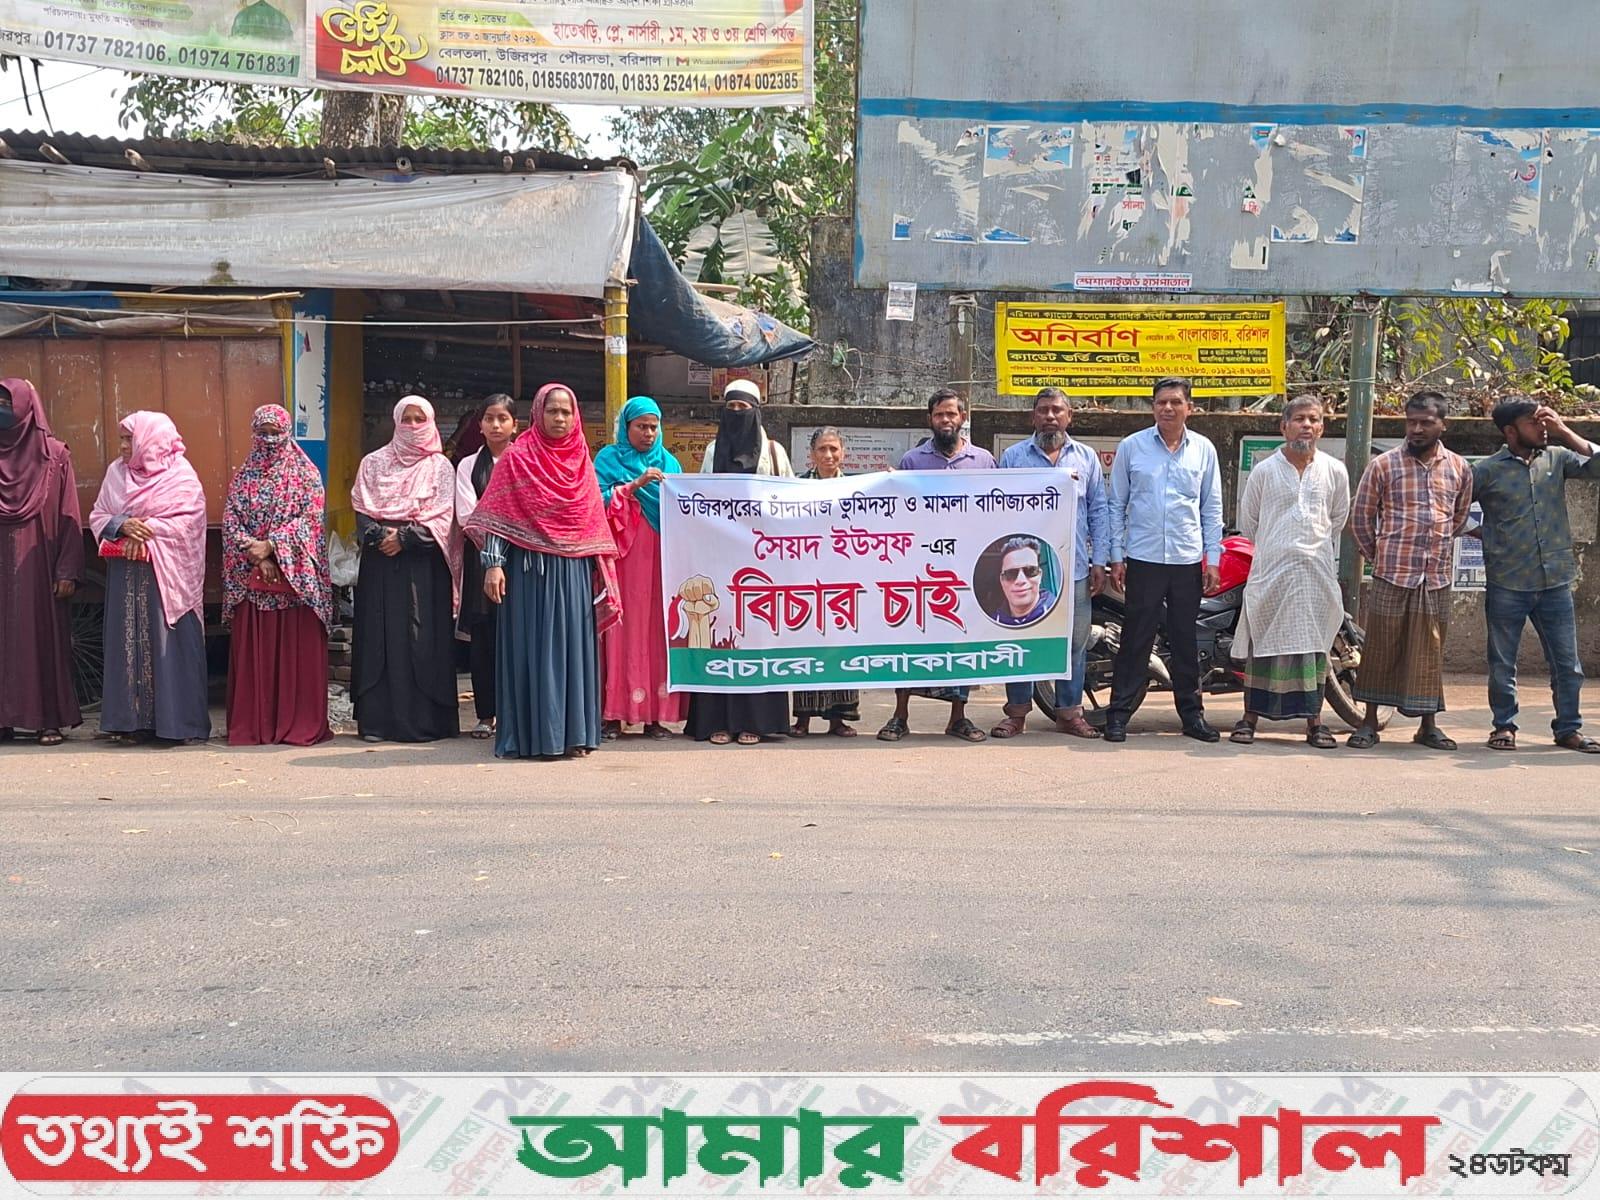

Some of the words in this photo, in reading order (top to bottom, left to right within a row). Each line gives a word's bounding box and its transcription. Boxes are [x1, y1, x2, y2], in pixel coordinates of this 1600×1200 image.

[711, 27, 720, 41] ও
[44, 31, 98, 54] 01737
[103, 38, 172, 64] 782106,
[178, 47, 230, 69] 01974
[236, 53, 296, 74] 761831
[496, 47, 548, 65] উজিরপুর
[559, 50, 613, 67] পৌরসভা,
[619, 52, 663, 67] বরিশাল
[436, 66, 475, 85] 01737
[478, 68, 530, 91] 782106,
[622, 74, 660, 92] 01833
[714, 74, 750, 91] 01874
[754, 72, 799, 90] 002385
[1010, 323, 1141, 348] অনির্বাণ
[1177, 326, 1232, 344] বাংলাবাজার,
[1236, 323, 1270, 343] বরিশাল
[1009, 351, 1057, 362] ক্যাডেট
[1062, 351, 1090, 362] ভর্তি
[677, 493, 763, 521] উজিরপুরের
[768, 488, 832, 519] চাঁদাবাজ
[904, 498, 917, 514] ও
[923, 493, 969, 514] মামলা
[974, 489, 1062, 514] বাণিজ্যকারী
[752, 528, 823, 562] সৈয়দ
[831, 526, 916, 564] ইউসুফ
[726, 566, 867, 637] বিচার
[875, 563, 973, 634] চাই
[840, 643, 1032, 674] এলাকাবাসী
